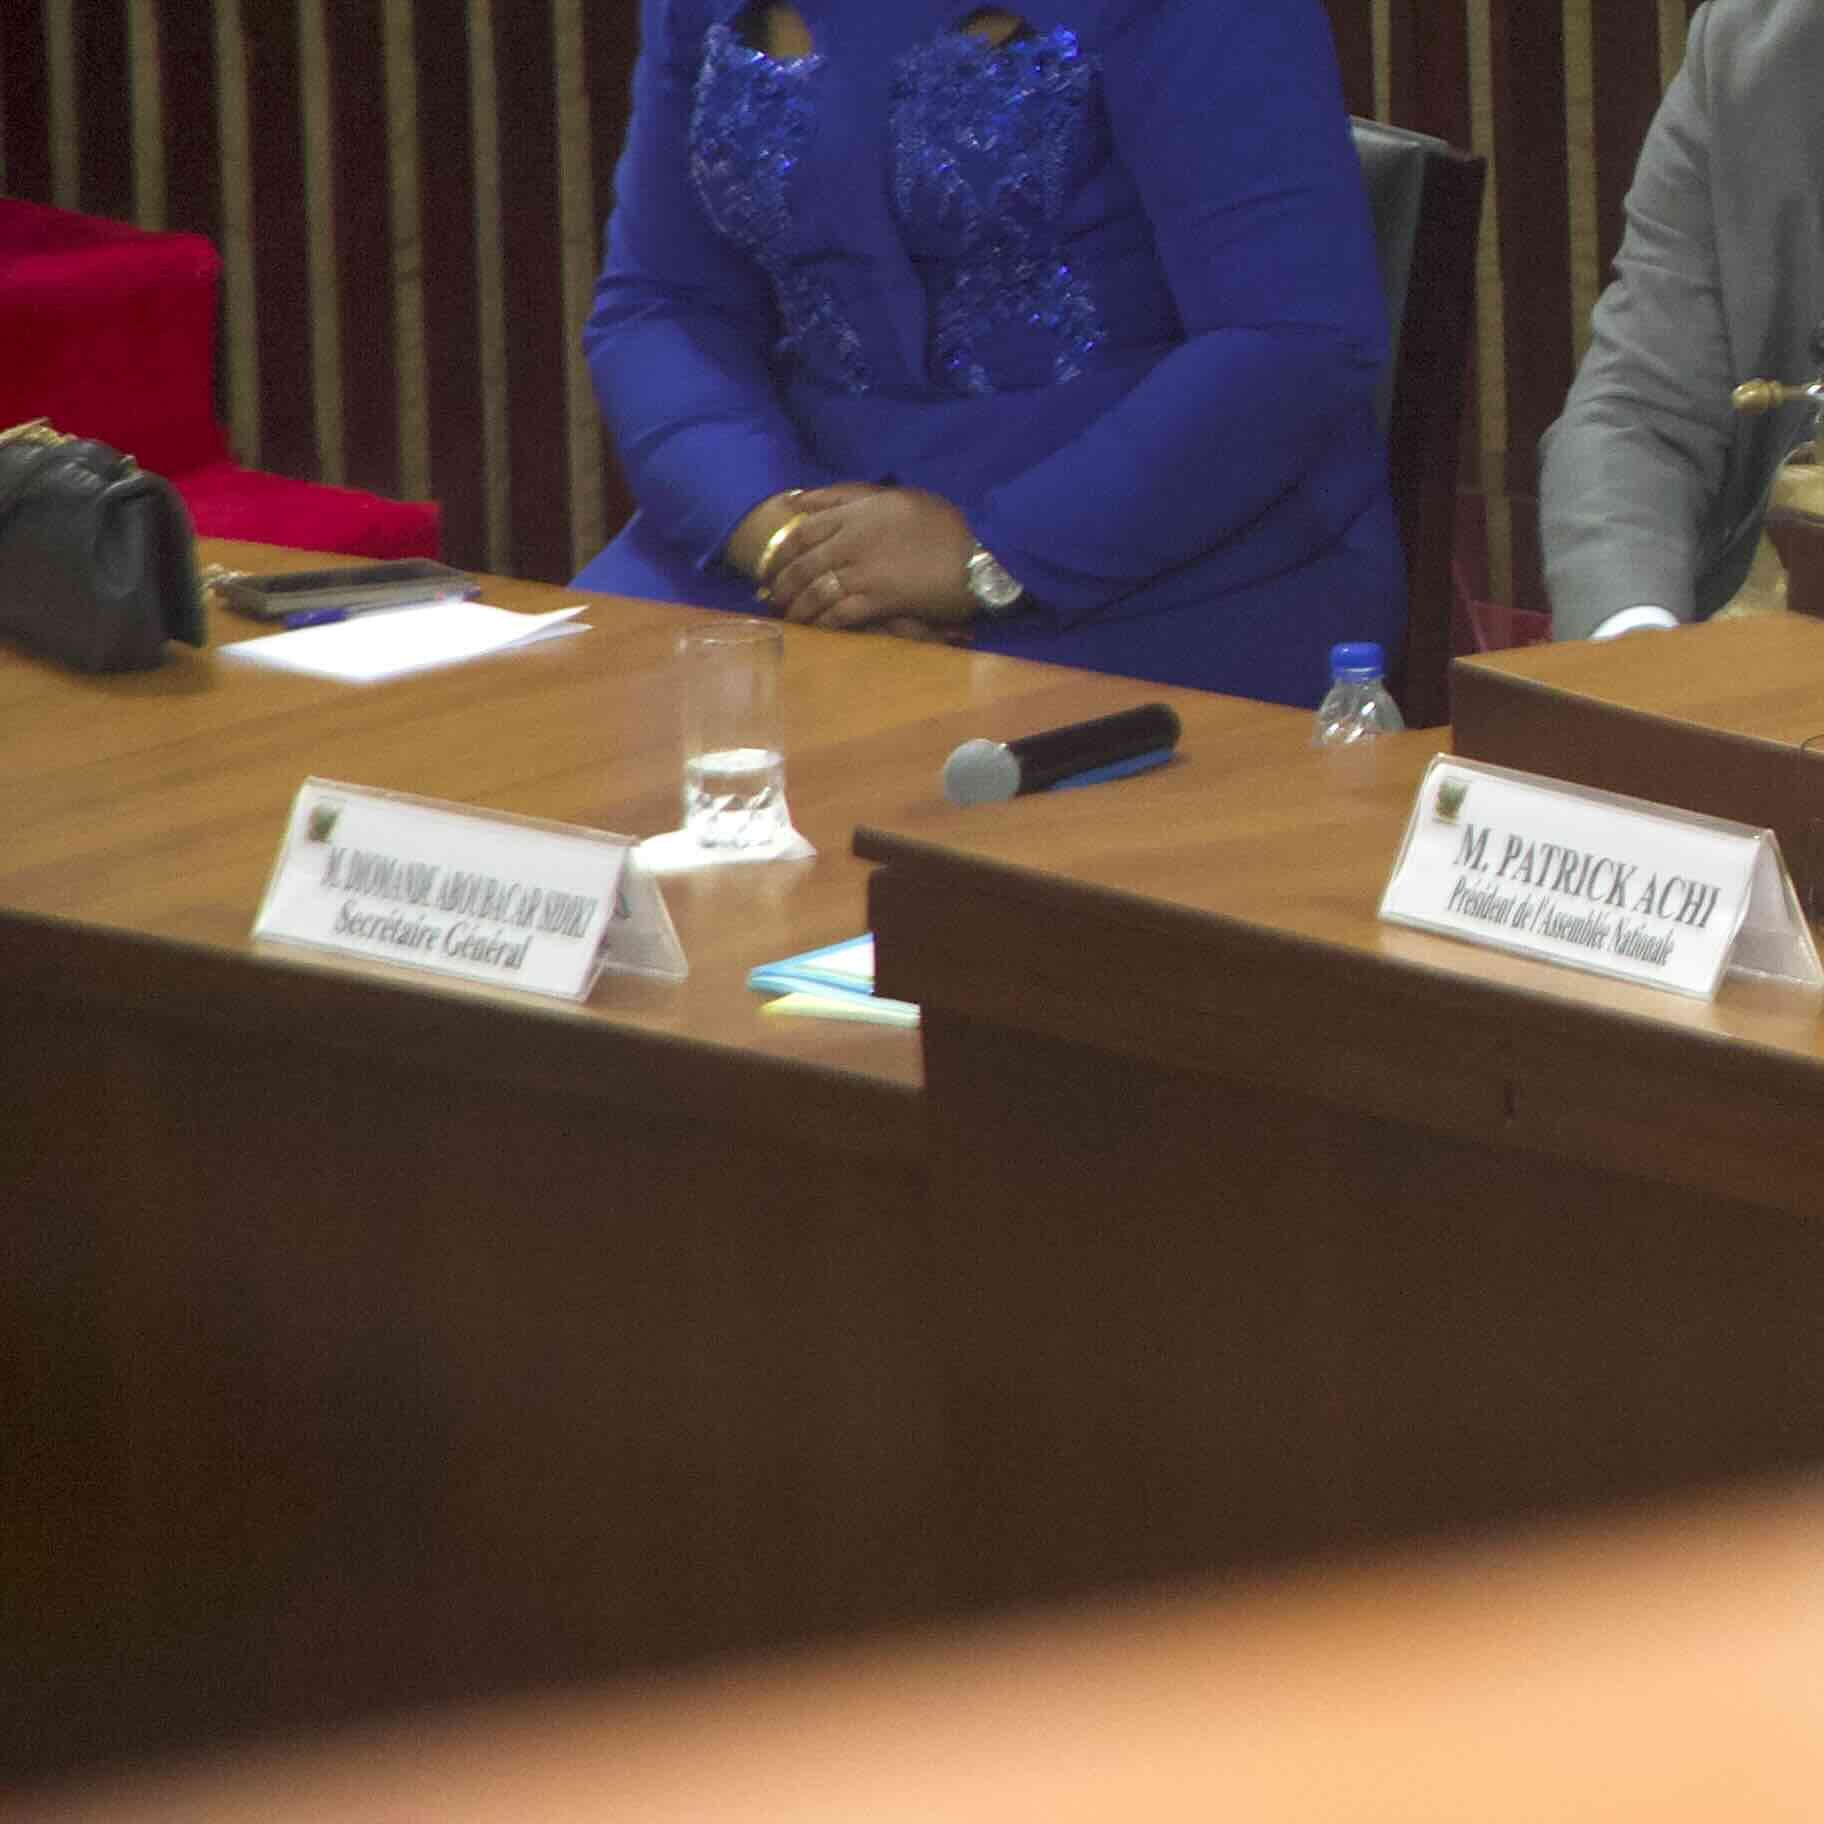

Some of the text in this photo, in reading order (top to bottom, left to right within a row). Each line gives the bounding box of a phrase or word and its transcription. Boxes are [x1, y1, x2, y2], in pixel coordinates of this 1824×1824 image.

[1447, 876, 1674, 966] Président de l'Assemblée Nationale
[1453, 824, 1721, 928] M. PATRICK ACHI
[335, 898, 535, 970] Secrétaire Général
